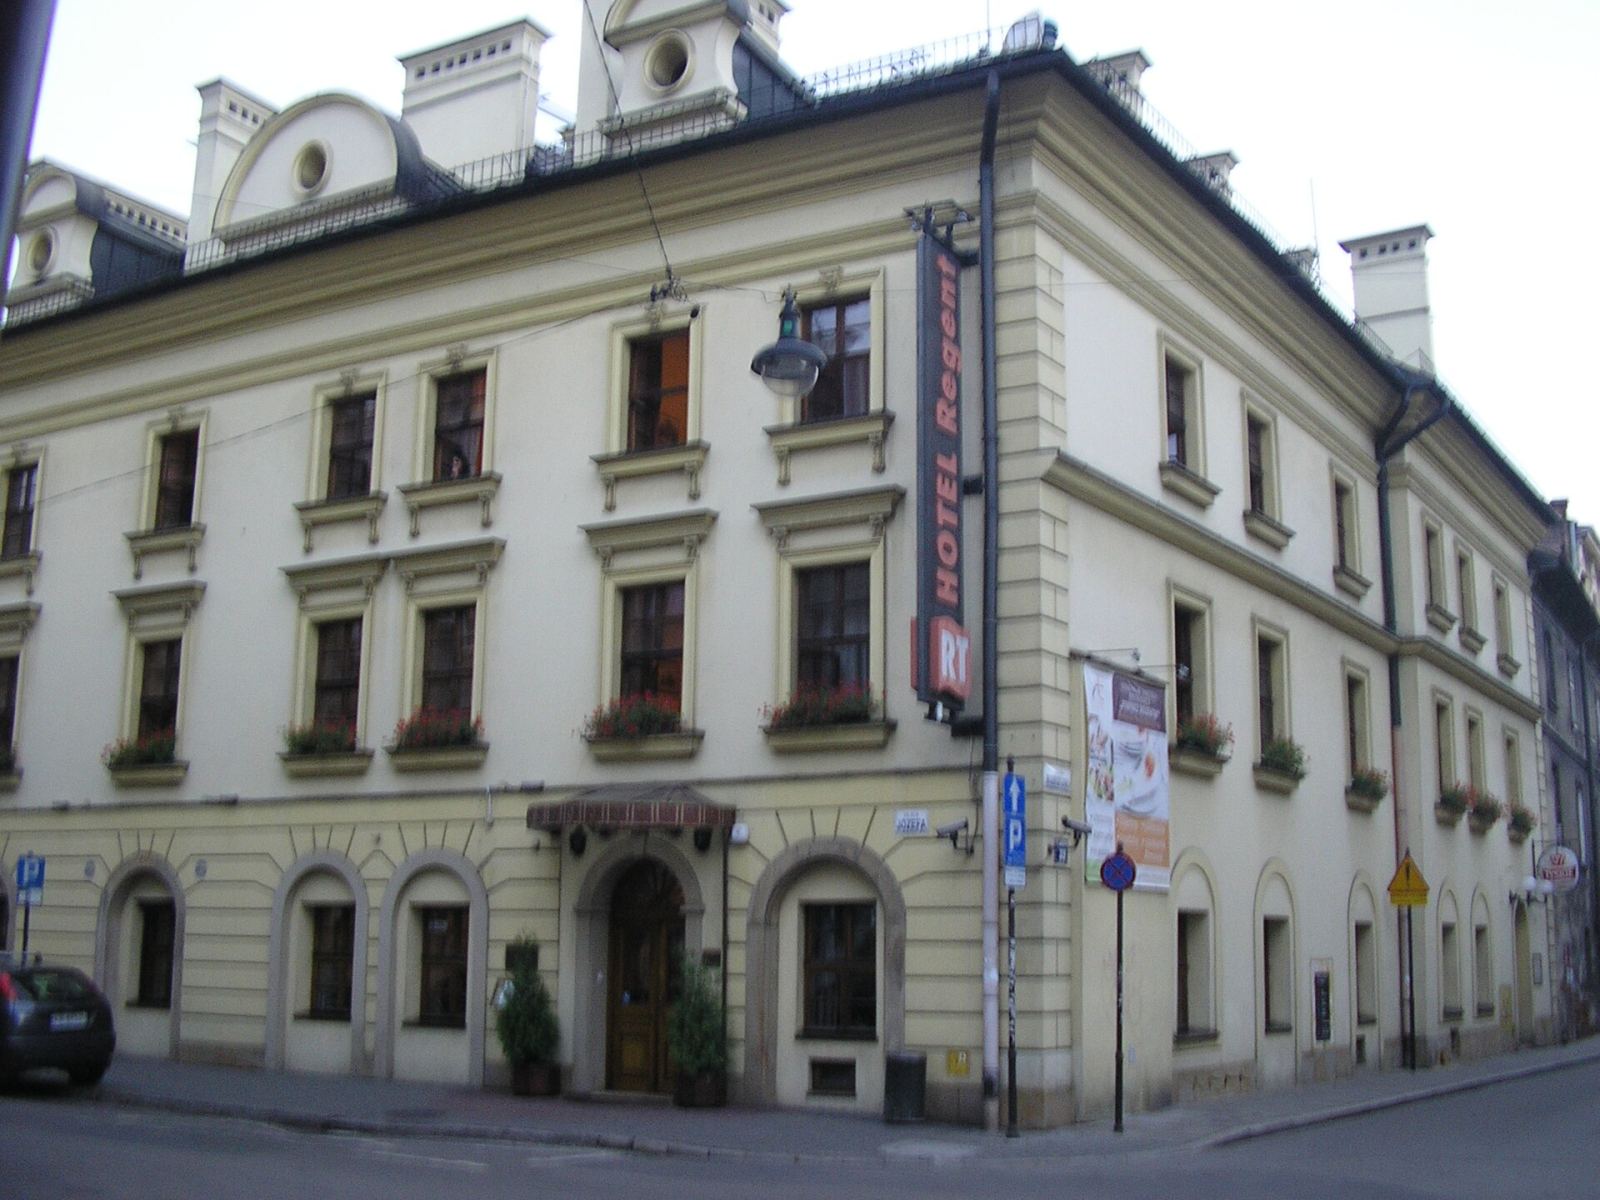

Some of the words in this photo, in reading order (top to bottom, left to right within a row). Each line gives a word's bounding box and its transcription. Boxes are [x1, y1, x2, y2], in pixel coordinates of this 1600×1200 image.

[936, 253, 962, 435] Regent
[936, 453, 959, 607] HOTEL
[942, 629, 969, 685] RT
[1009, 818, 1022, 852] P
[24, 859, 39, 885] P
